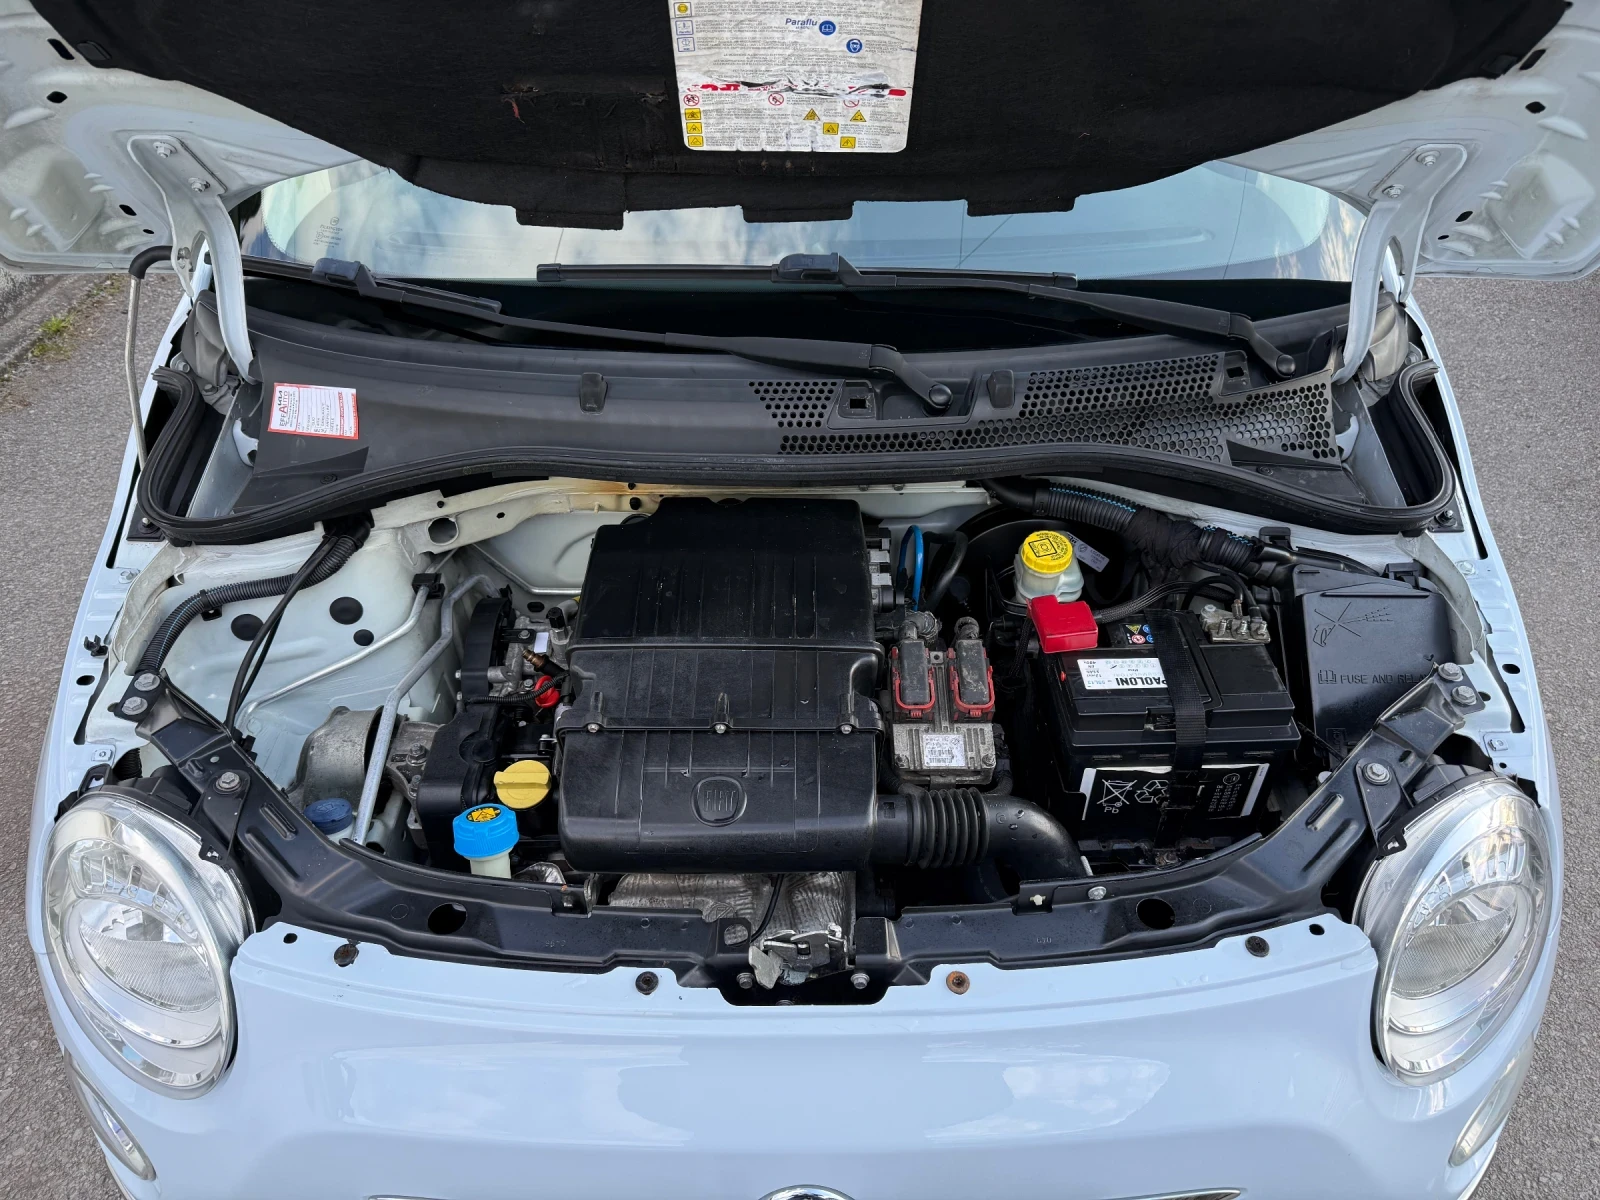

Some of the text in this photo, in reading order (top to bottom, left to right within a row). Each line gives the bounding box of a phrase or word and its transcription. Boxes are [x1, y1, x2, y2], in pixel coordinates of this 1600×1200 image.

[785, 18, 818, 26] Paraflu
[1340, 674, 1427, 685] FUSE AND RELA
[704, 790, 736, 812] FIAT
[1104, 806, 1119, 814] Pb
